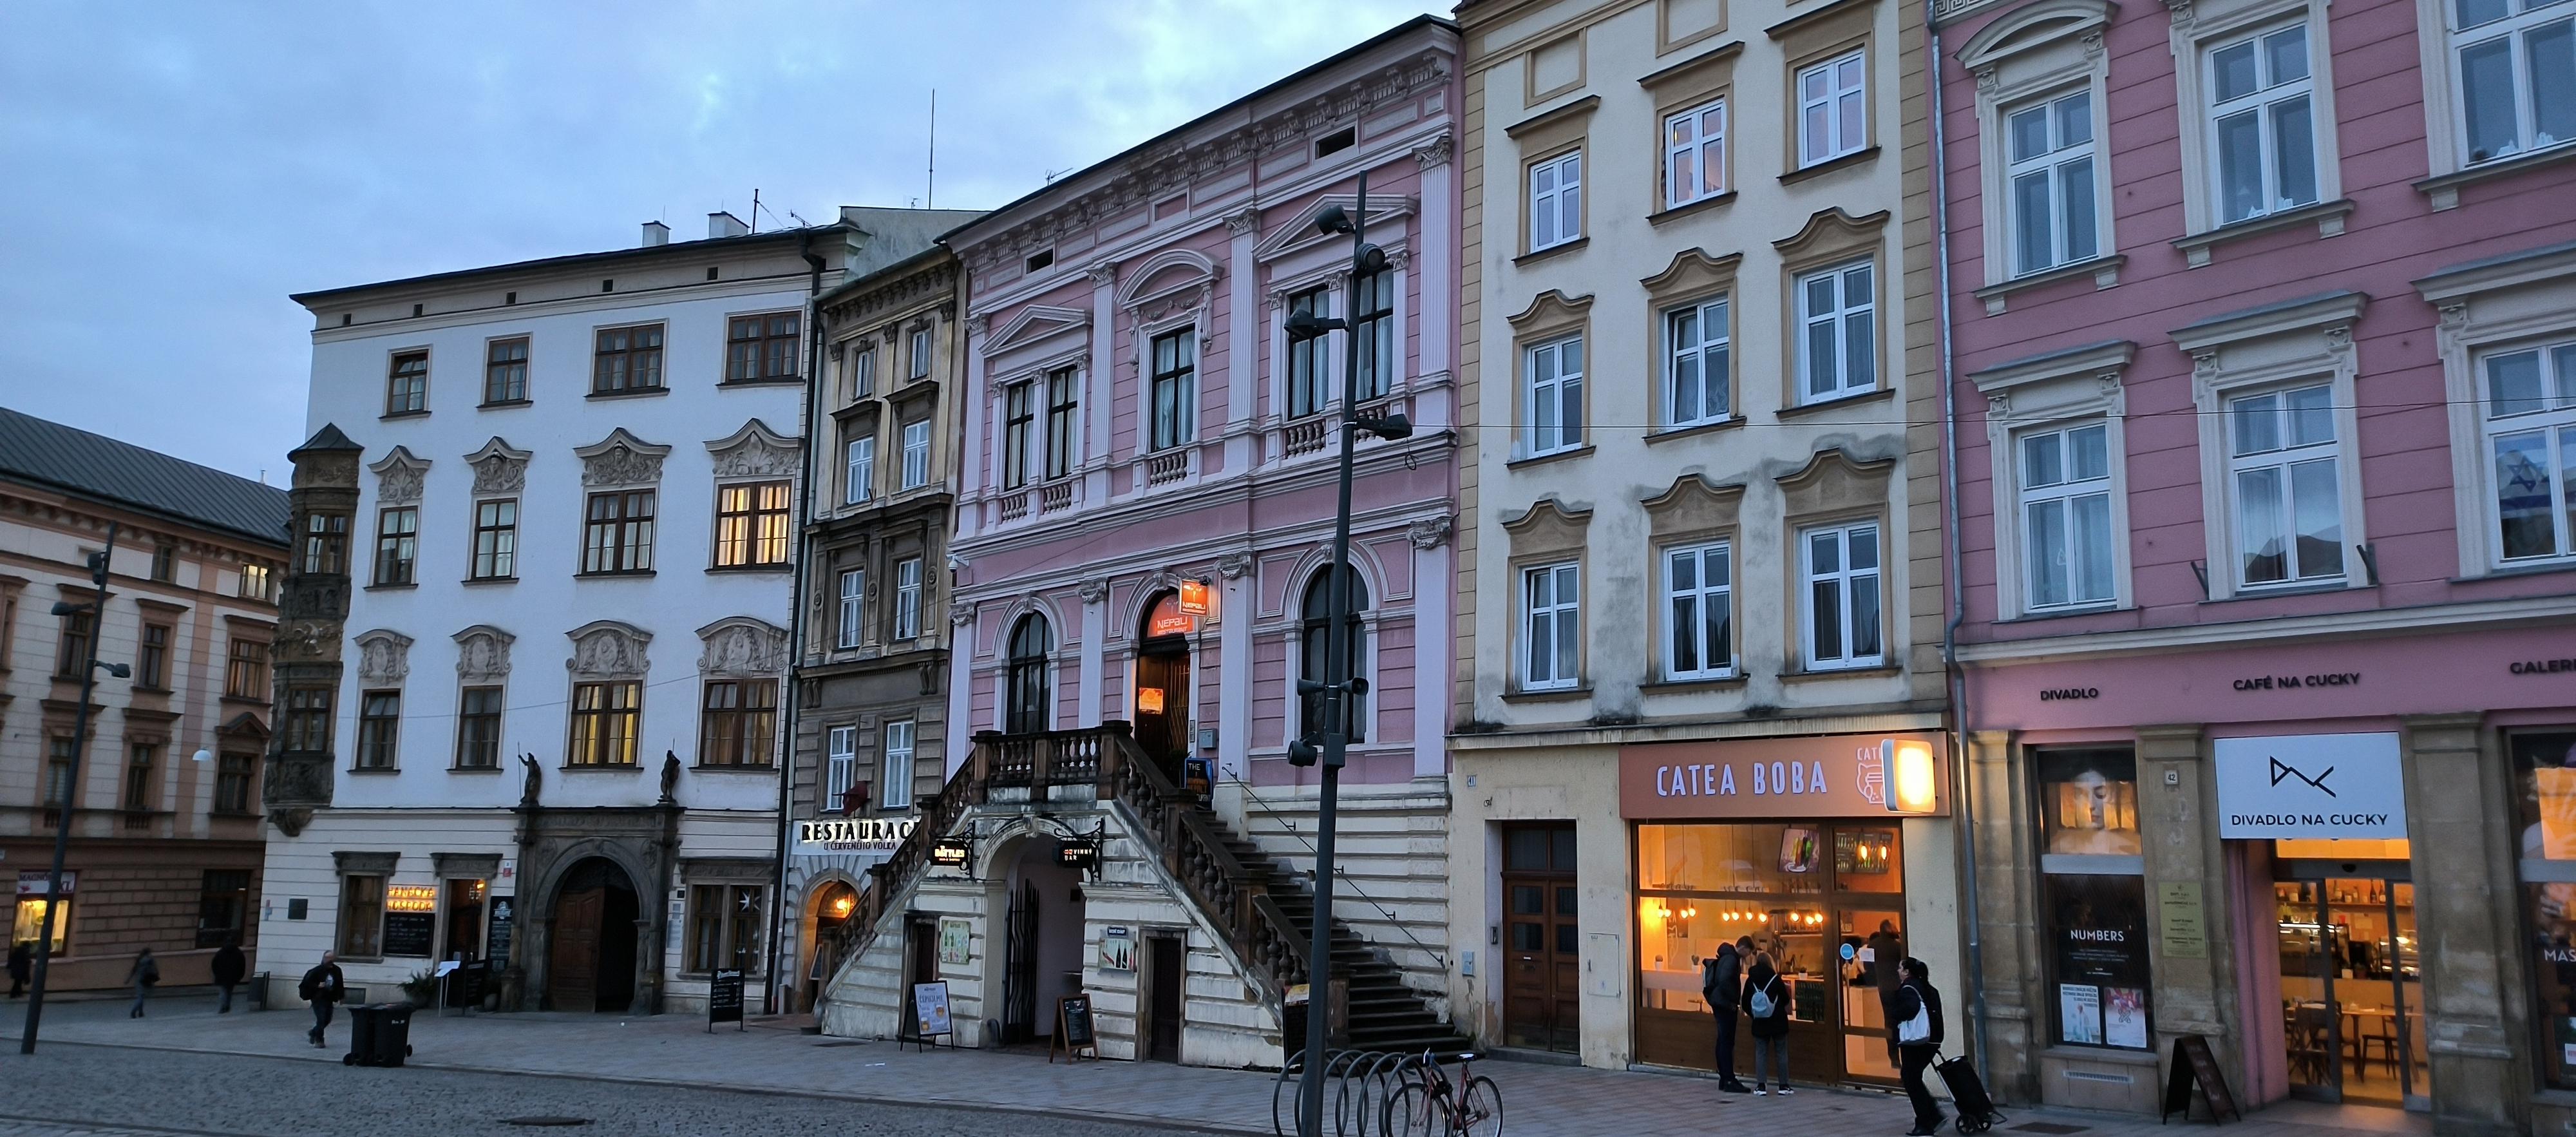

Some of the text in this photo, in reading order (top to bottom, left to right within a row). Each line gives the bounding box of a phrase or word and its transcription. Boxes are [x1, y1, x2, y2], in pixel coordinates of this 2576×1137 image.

[2233, 673, 2360, 691] CAFÉ NA CUCKY
[2040, 688, 2099, 701] DIVADLO
[1657, 761, 1827, 796] CATEA BOBA
[2231, 814, 2388, 826] DIVADLO NA CUCKY
[824, 842, 828, 850] U
[386, 901, 433, 911] HOSPODA
[2070, 930, 2124, 941] NUMBERS
